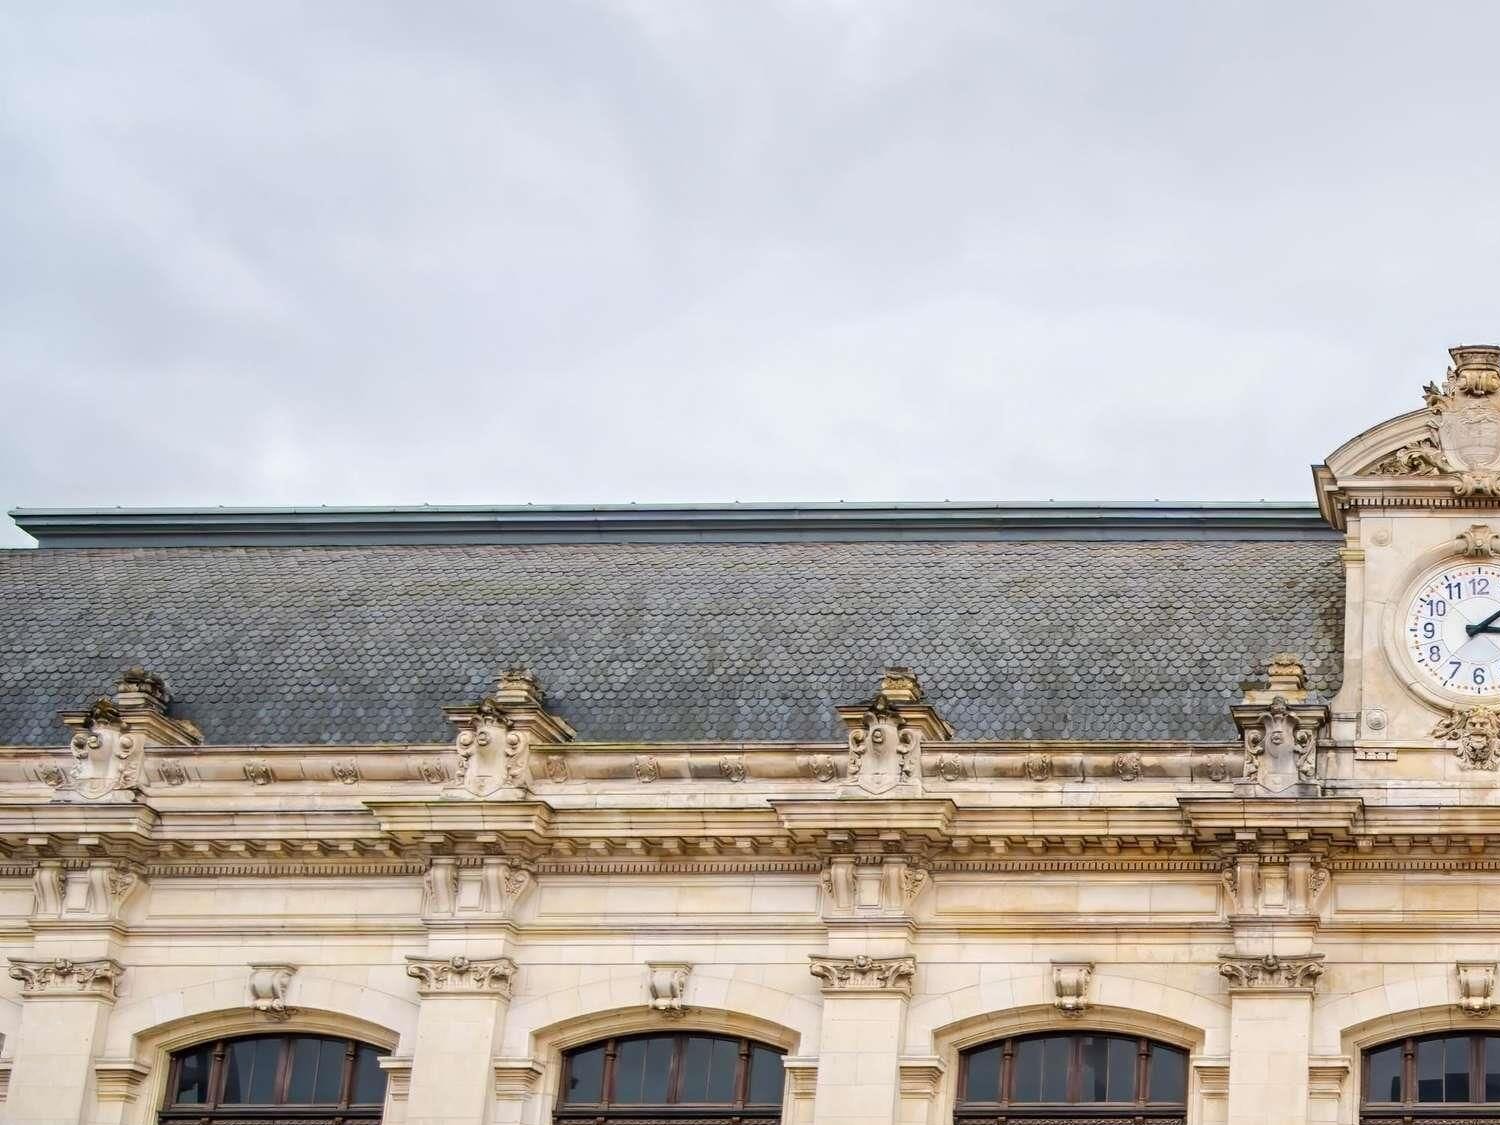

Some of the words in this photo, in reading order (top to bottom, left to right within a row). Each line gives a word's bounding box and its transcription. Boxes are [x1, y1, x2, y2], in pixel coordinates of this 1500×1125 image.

[1445, 582, 1462, 600] 11
[1468, 578, 1490, 596] 12
[1426, 600, 1446, 617] 10
[1423, 622, 1435, 639] 9
[1429, 645, 1441, 663] 8
[1449, 661, 1462, 680] 7
[1473, 667, 1485, 685] 6
